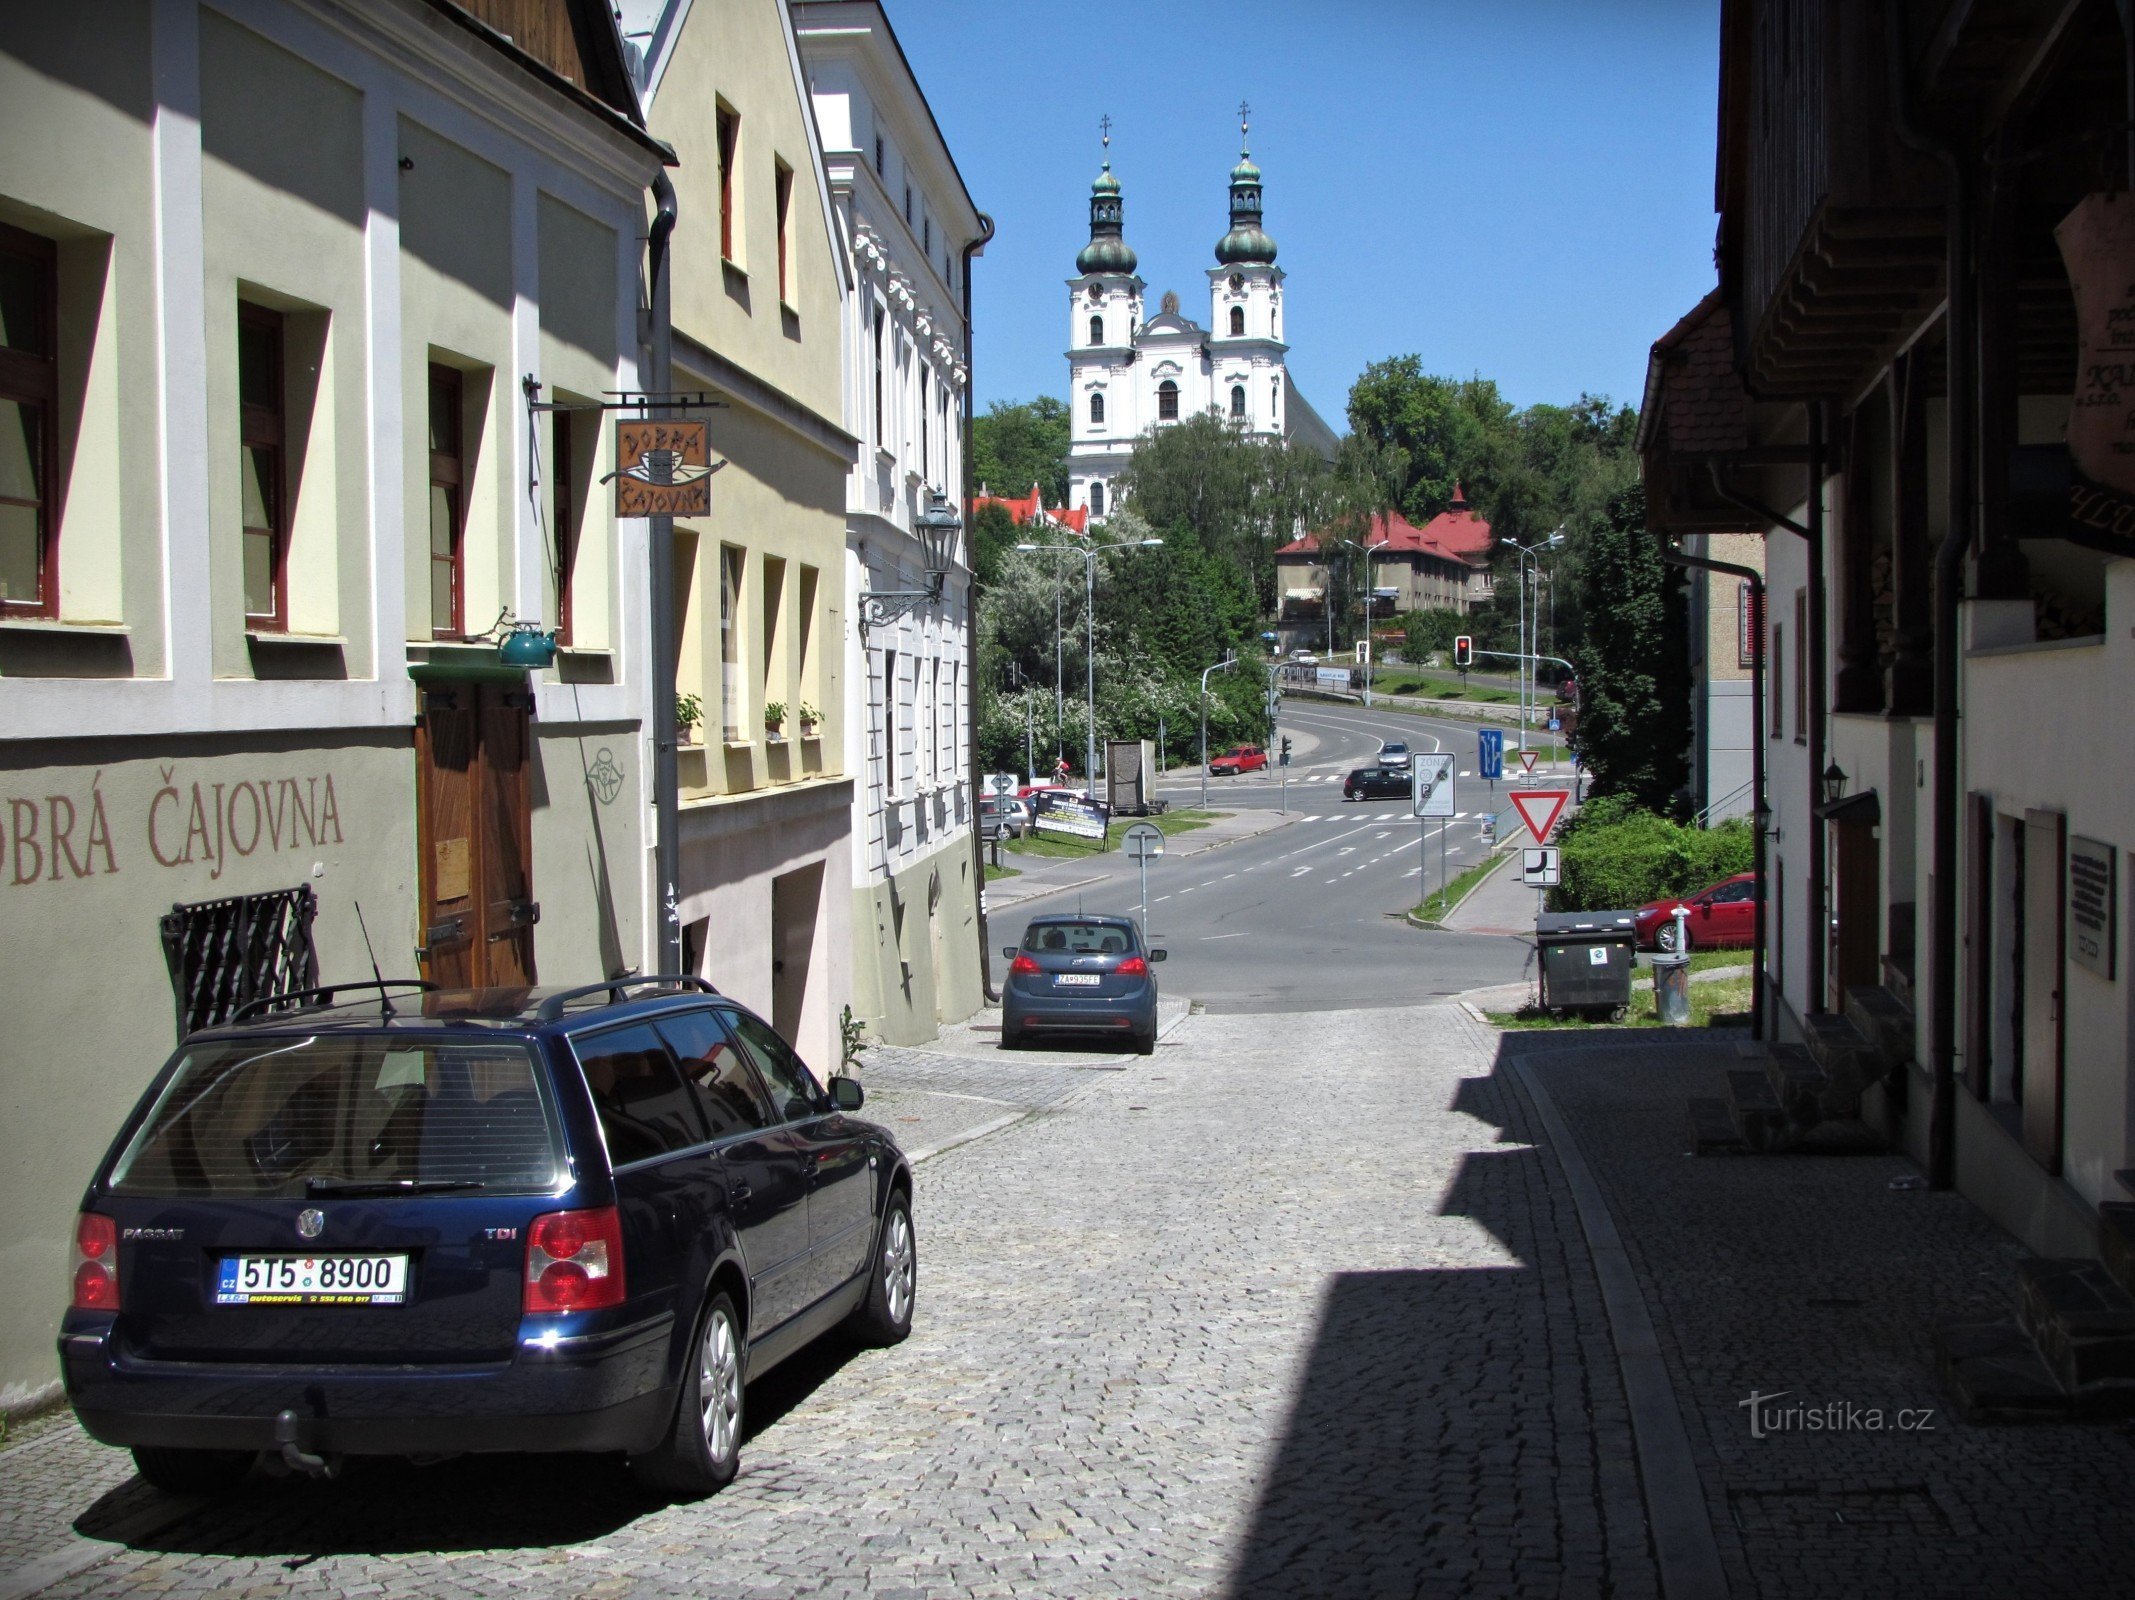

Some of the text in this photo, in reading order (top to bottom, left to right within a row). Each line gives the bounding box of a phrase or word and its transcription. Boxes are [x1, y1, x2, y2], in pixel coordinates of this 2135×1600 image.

[0, 769, 119, 886] BRÁ
[148, 764, 344, 880] ČAJOVNA
[123, 1228, 184, 1240] PASSAT
[485, 1227, 517, 1239] TDI
[244, 1258, 392, 1288] 5T5 8900
[222, 1279, 236, 1288] CZ
[250, 1294, 303, 1303] autoservis
